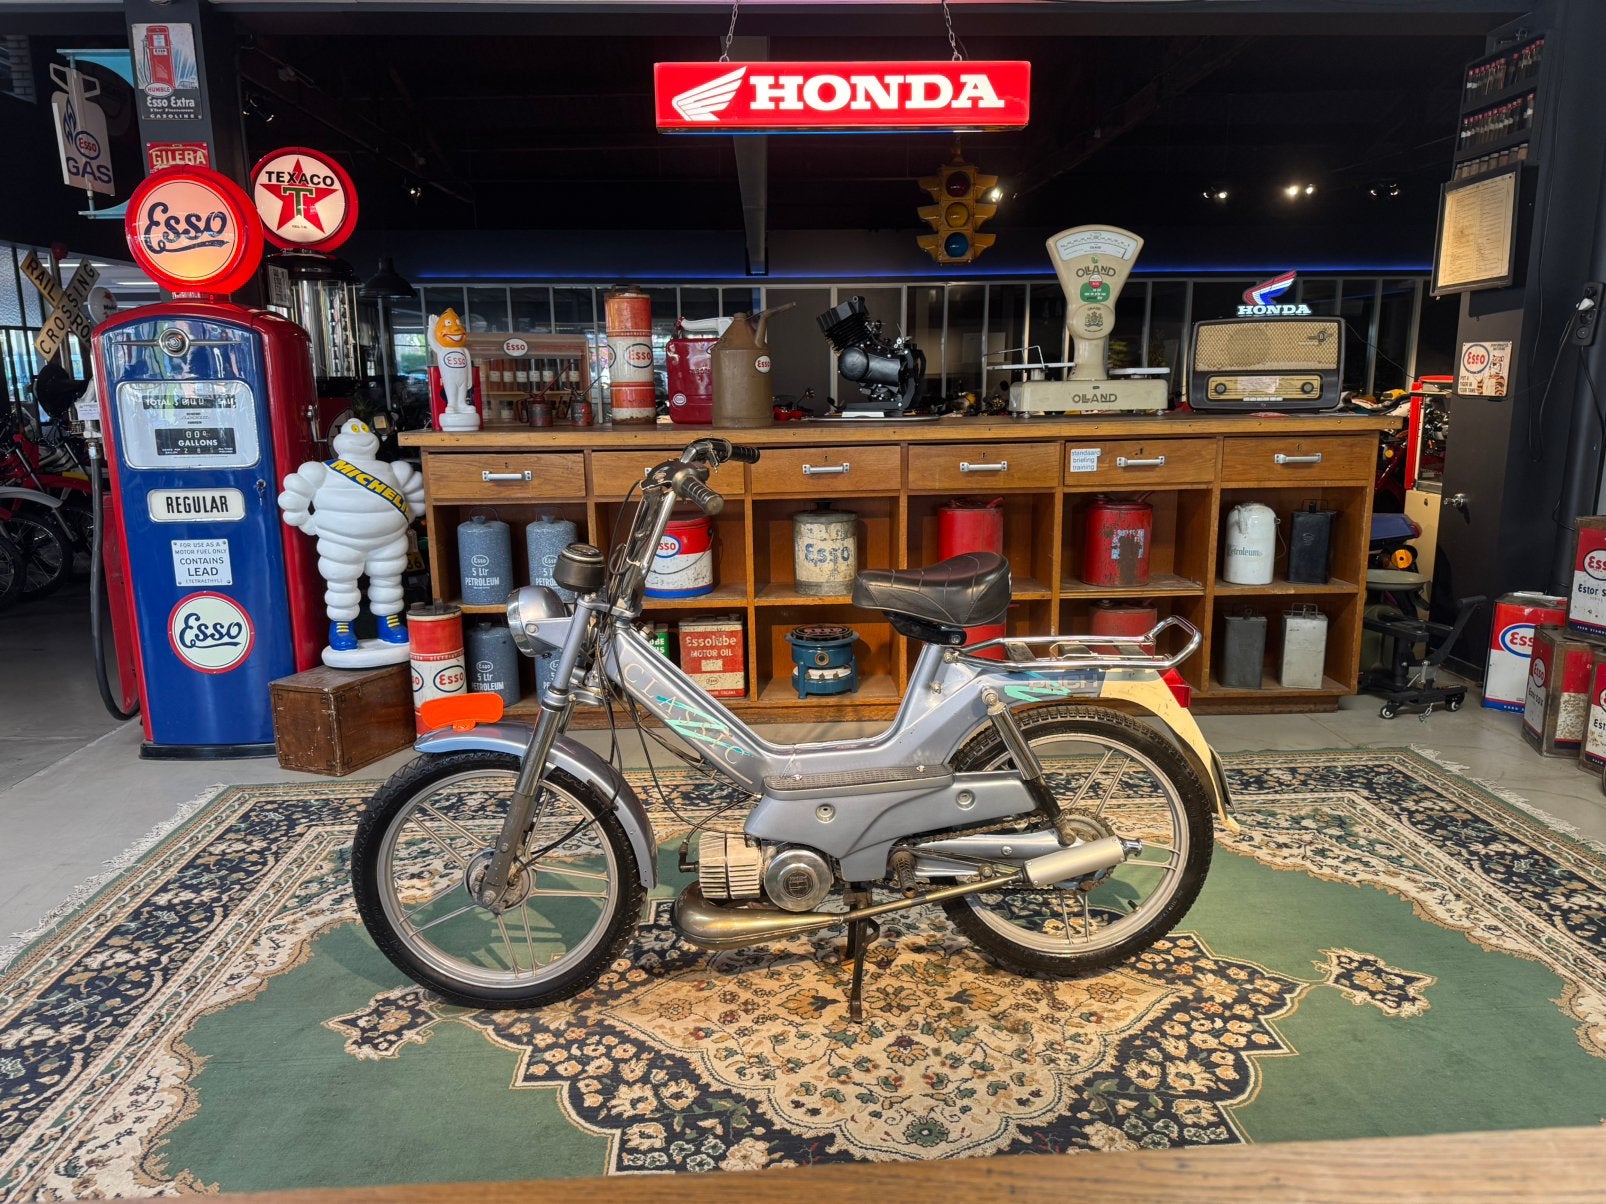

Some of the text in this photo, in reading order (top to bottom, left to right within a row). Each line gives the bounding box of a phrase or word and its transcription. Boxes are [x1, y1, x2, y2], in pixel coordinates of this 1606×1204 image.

[749, 74, 1005, 111] HONDA
[146, 96, 195, 107] Esso Extra
[79, 137, 97, 153] Esso
[152, 150, 207, 165] GILERA
[66, 156, 112, 185] GAS
[265, 171, 335, 188] TEXACO
[144, 202, 229, 254] Esso
[1076, 265, 1117, 278] OLLAND
[26, 257, 92, 347] RAIL RO
[39, 262, 96, 356] CROSSING
[1237, 305, 1312, 315] HONDA
[1466, 351, 1486, 365] Esso
[145, 398, 171, 407] TOTAL
[1071, 393, 1118, 404] OLLAND
[178, 439, 219, 447] GALLONS
[165, 495, 229, 514] REGULAR
[179, 557, 225, 566] CONTAINS
[1588, 556, 1606, 570] Ess
[187, 567, 219, 577] LEAD
[472, 568, 489, 576] 5 Ltr
[465, 577, 500, 586] PETROLEUM
[1578, 583, 1599, 596] Estor
[179, 612, 243, 649] Esso
[686, 634, 737, 647] Essolube
[1509, 631, 1534, 647] Ess
[690, 648, 733, 657] MOTOR OIL
[438, 672, 464, 686] Esso
[477, 673, 493, 681] 5 Ltr
[624, 662, 747, 765] CLASSIC
